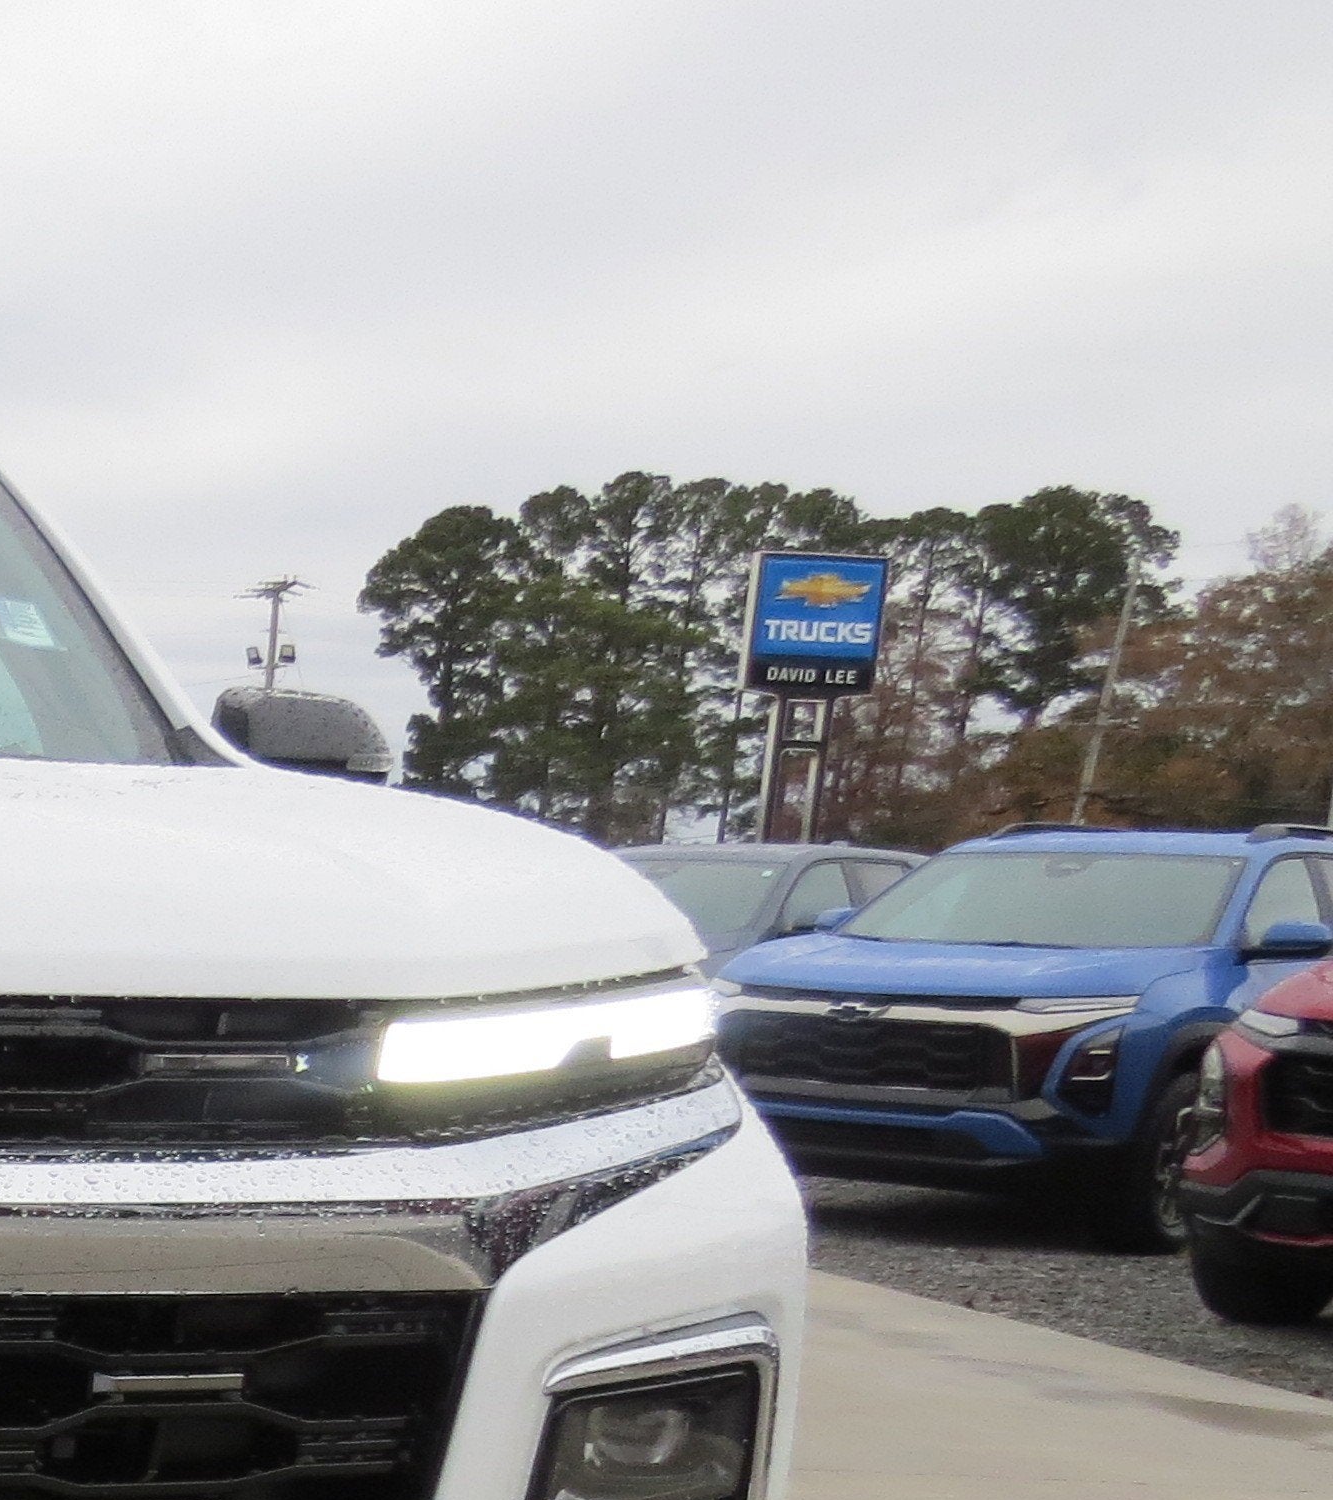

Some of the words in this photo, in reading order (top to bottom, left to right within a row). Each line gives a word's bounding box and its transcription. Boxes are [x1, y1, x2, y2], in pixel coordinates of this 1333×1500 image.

[764, 619, 875, 644] TRUCKS
[766, 666, 816, 683] DAVID
[825, 668, 858, 685] LEE
